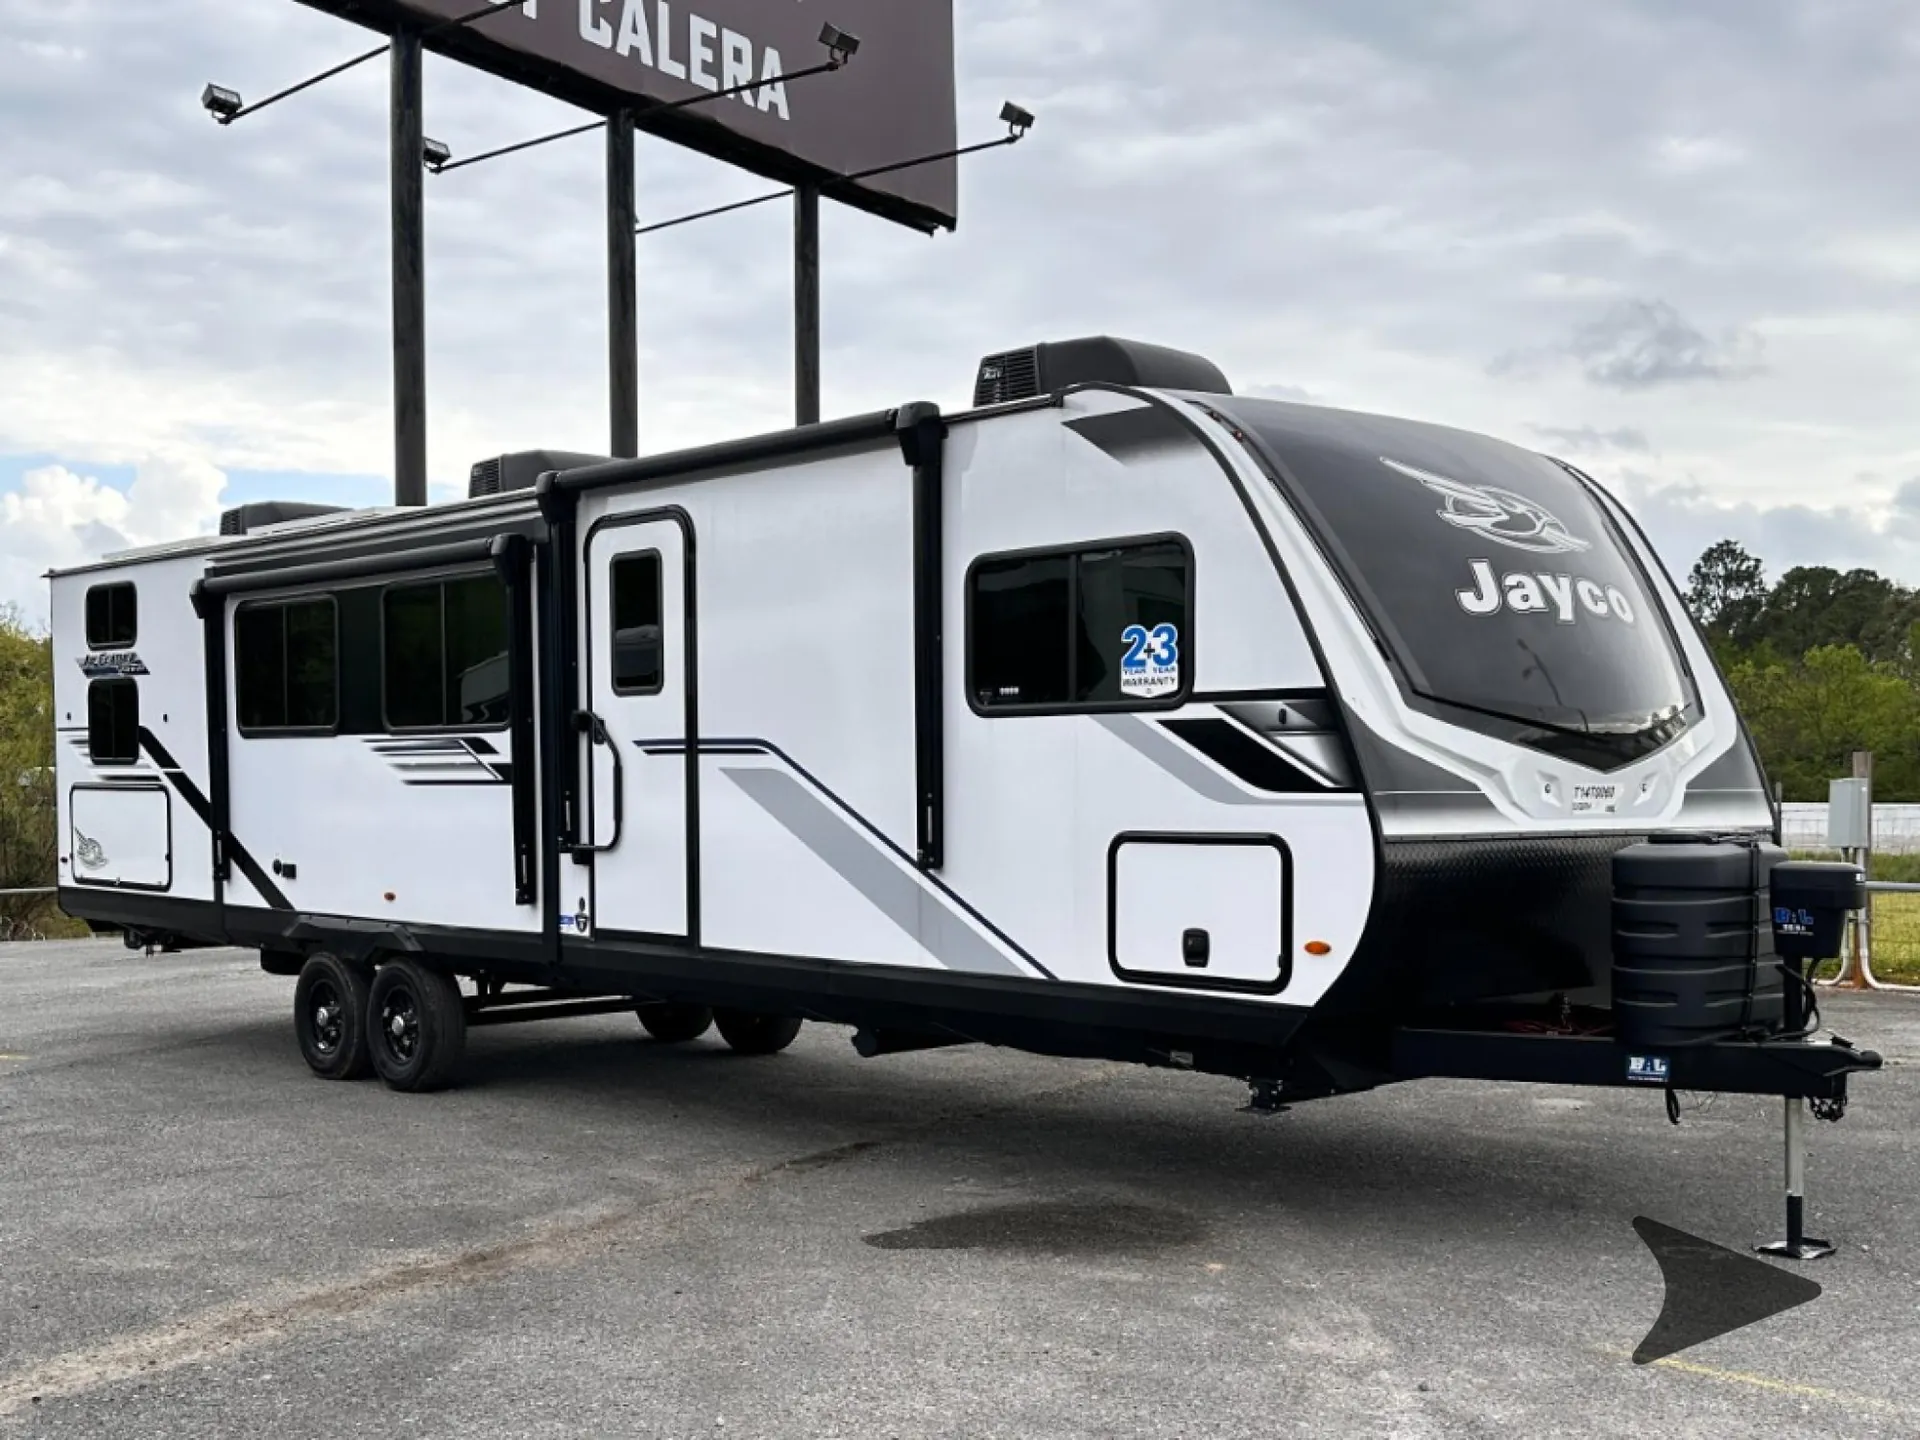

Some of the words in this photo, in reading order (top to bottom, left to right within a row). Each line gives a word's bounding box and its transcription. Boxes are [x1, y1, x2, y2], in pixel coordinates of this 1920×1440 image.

[578, 0, 791, 121] CALERA
[1456, 558, 1636, 624] Jayco
[1122, 676, 1176, 687] WARRANTY
